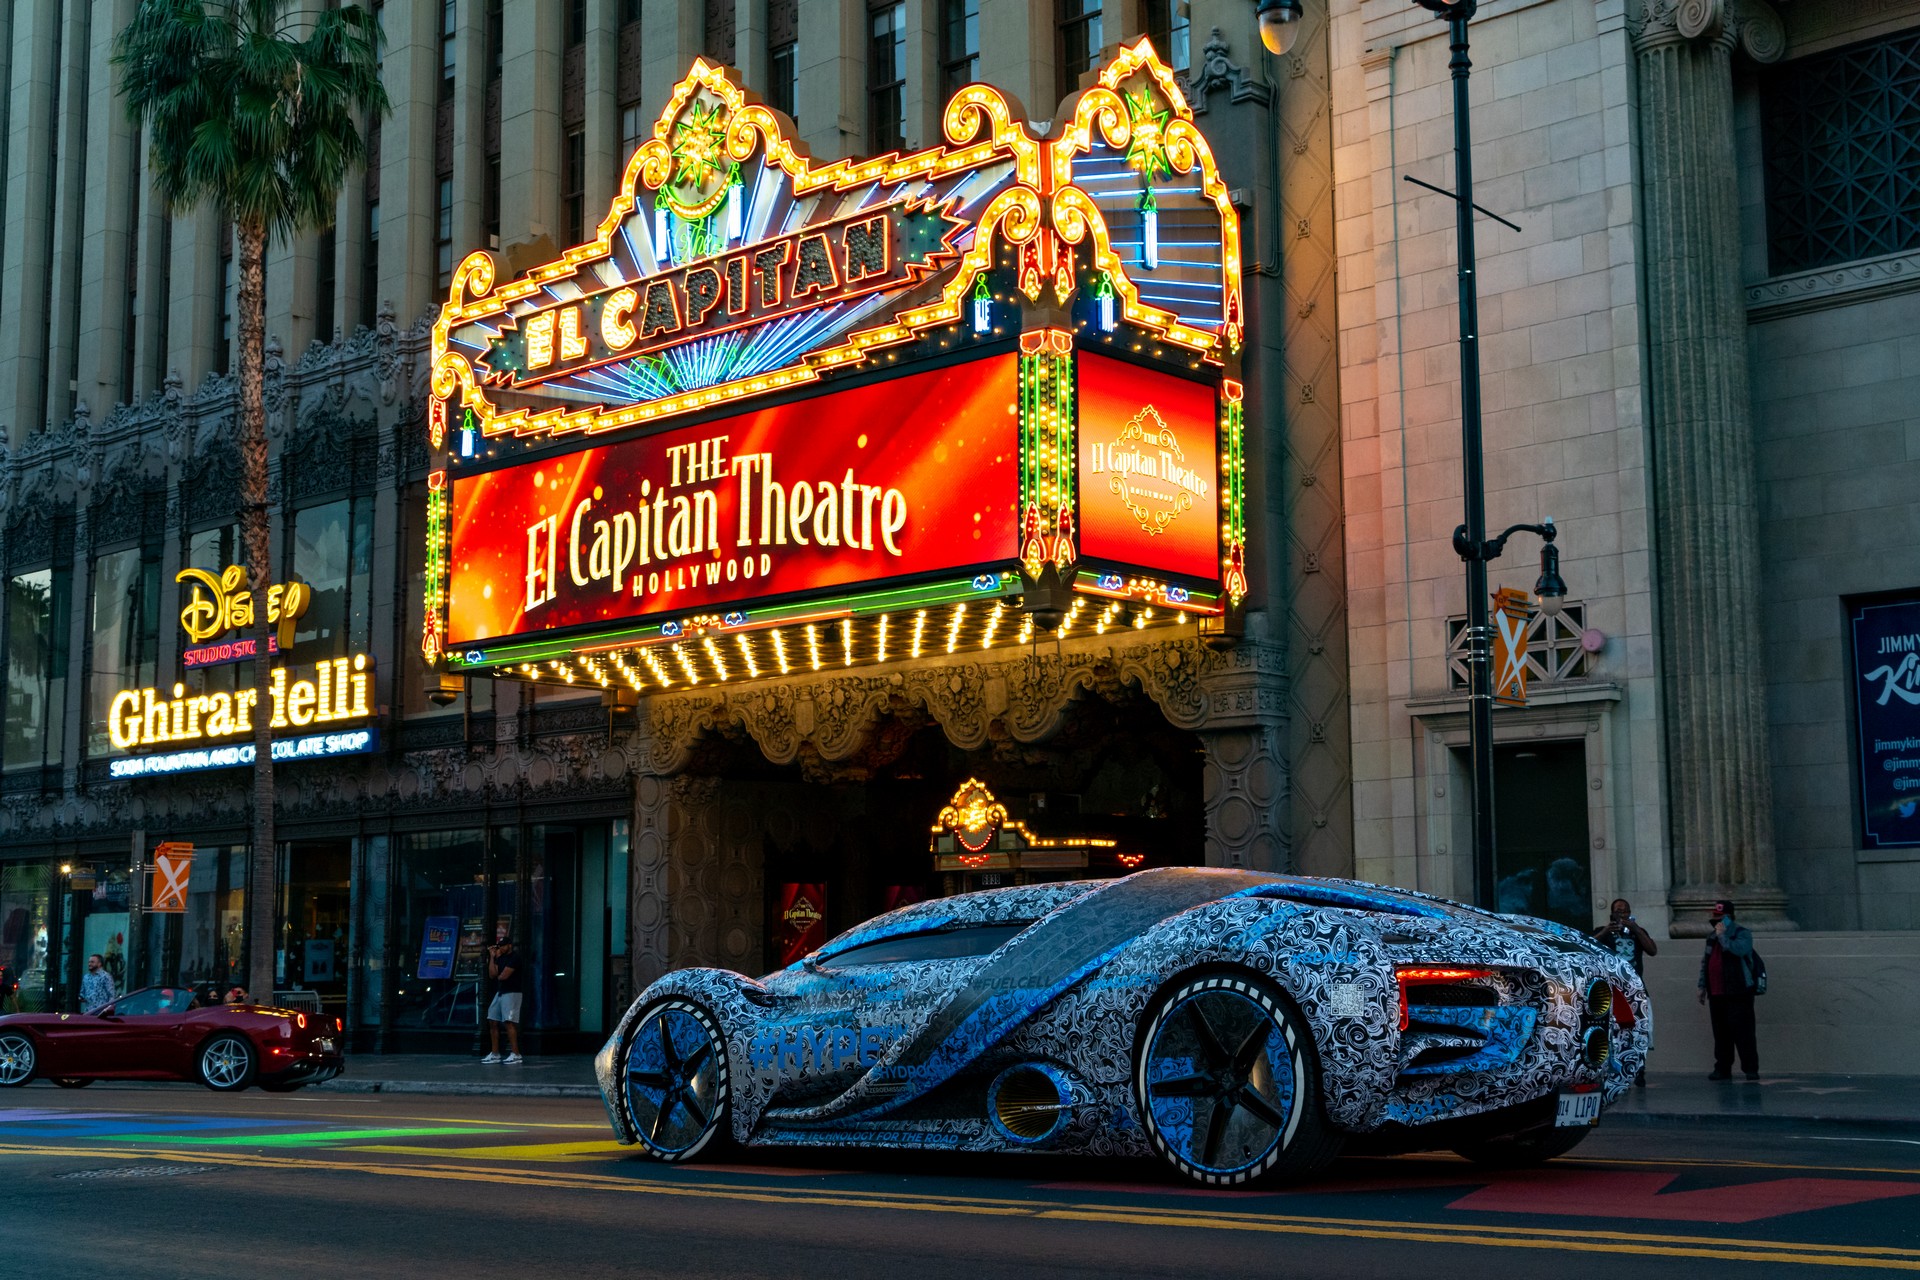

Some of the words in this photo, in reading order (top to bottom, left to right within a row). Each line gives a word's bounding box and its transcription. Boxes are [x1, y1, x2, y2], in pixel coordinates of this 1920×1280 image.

[673, 222, 719, 264] The
[524, 306, 589, 371] EL
[601, 213, 891, 351] CAPITAN
[666, 435, 729, 487] THE
[1142, 432, 1159, 447] THE
[1091, 442, 1104, 474] El
[1107, 442, 1157, 479] Capitan
[1159, 450, 1208, 501] Theatre
[524, 513, 557, 612] El
[569, 478, 719, 593] Capitan
[731, 452, 907, 557] Theatre
[633, 553, 771, 597] HOLLYWOOD
[183, 644, 232, 666] STUDIO
[232, 636, 278, 659] STOE
[110, 758, 144, 777] SODA
[145, 750, 208, 772] FOUNTAIN
[209, 747, 239, 765] AND
[239, 736, 325, 763] CHCOLATE
[325, 731, 370, 753] SHOP
[973, 975, 1050, 990] #FUELCELL
[775, 1131, 805, 1140] SPACE
[808, 1131, 875, 1141] TECHNOLOGY
[877, 1132, 899, 1141] FOR
[900, 1133, 924, 1142] THE
[925, 1134, 959, 1144] ROAD
